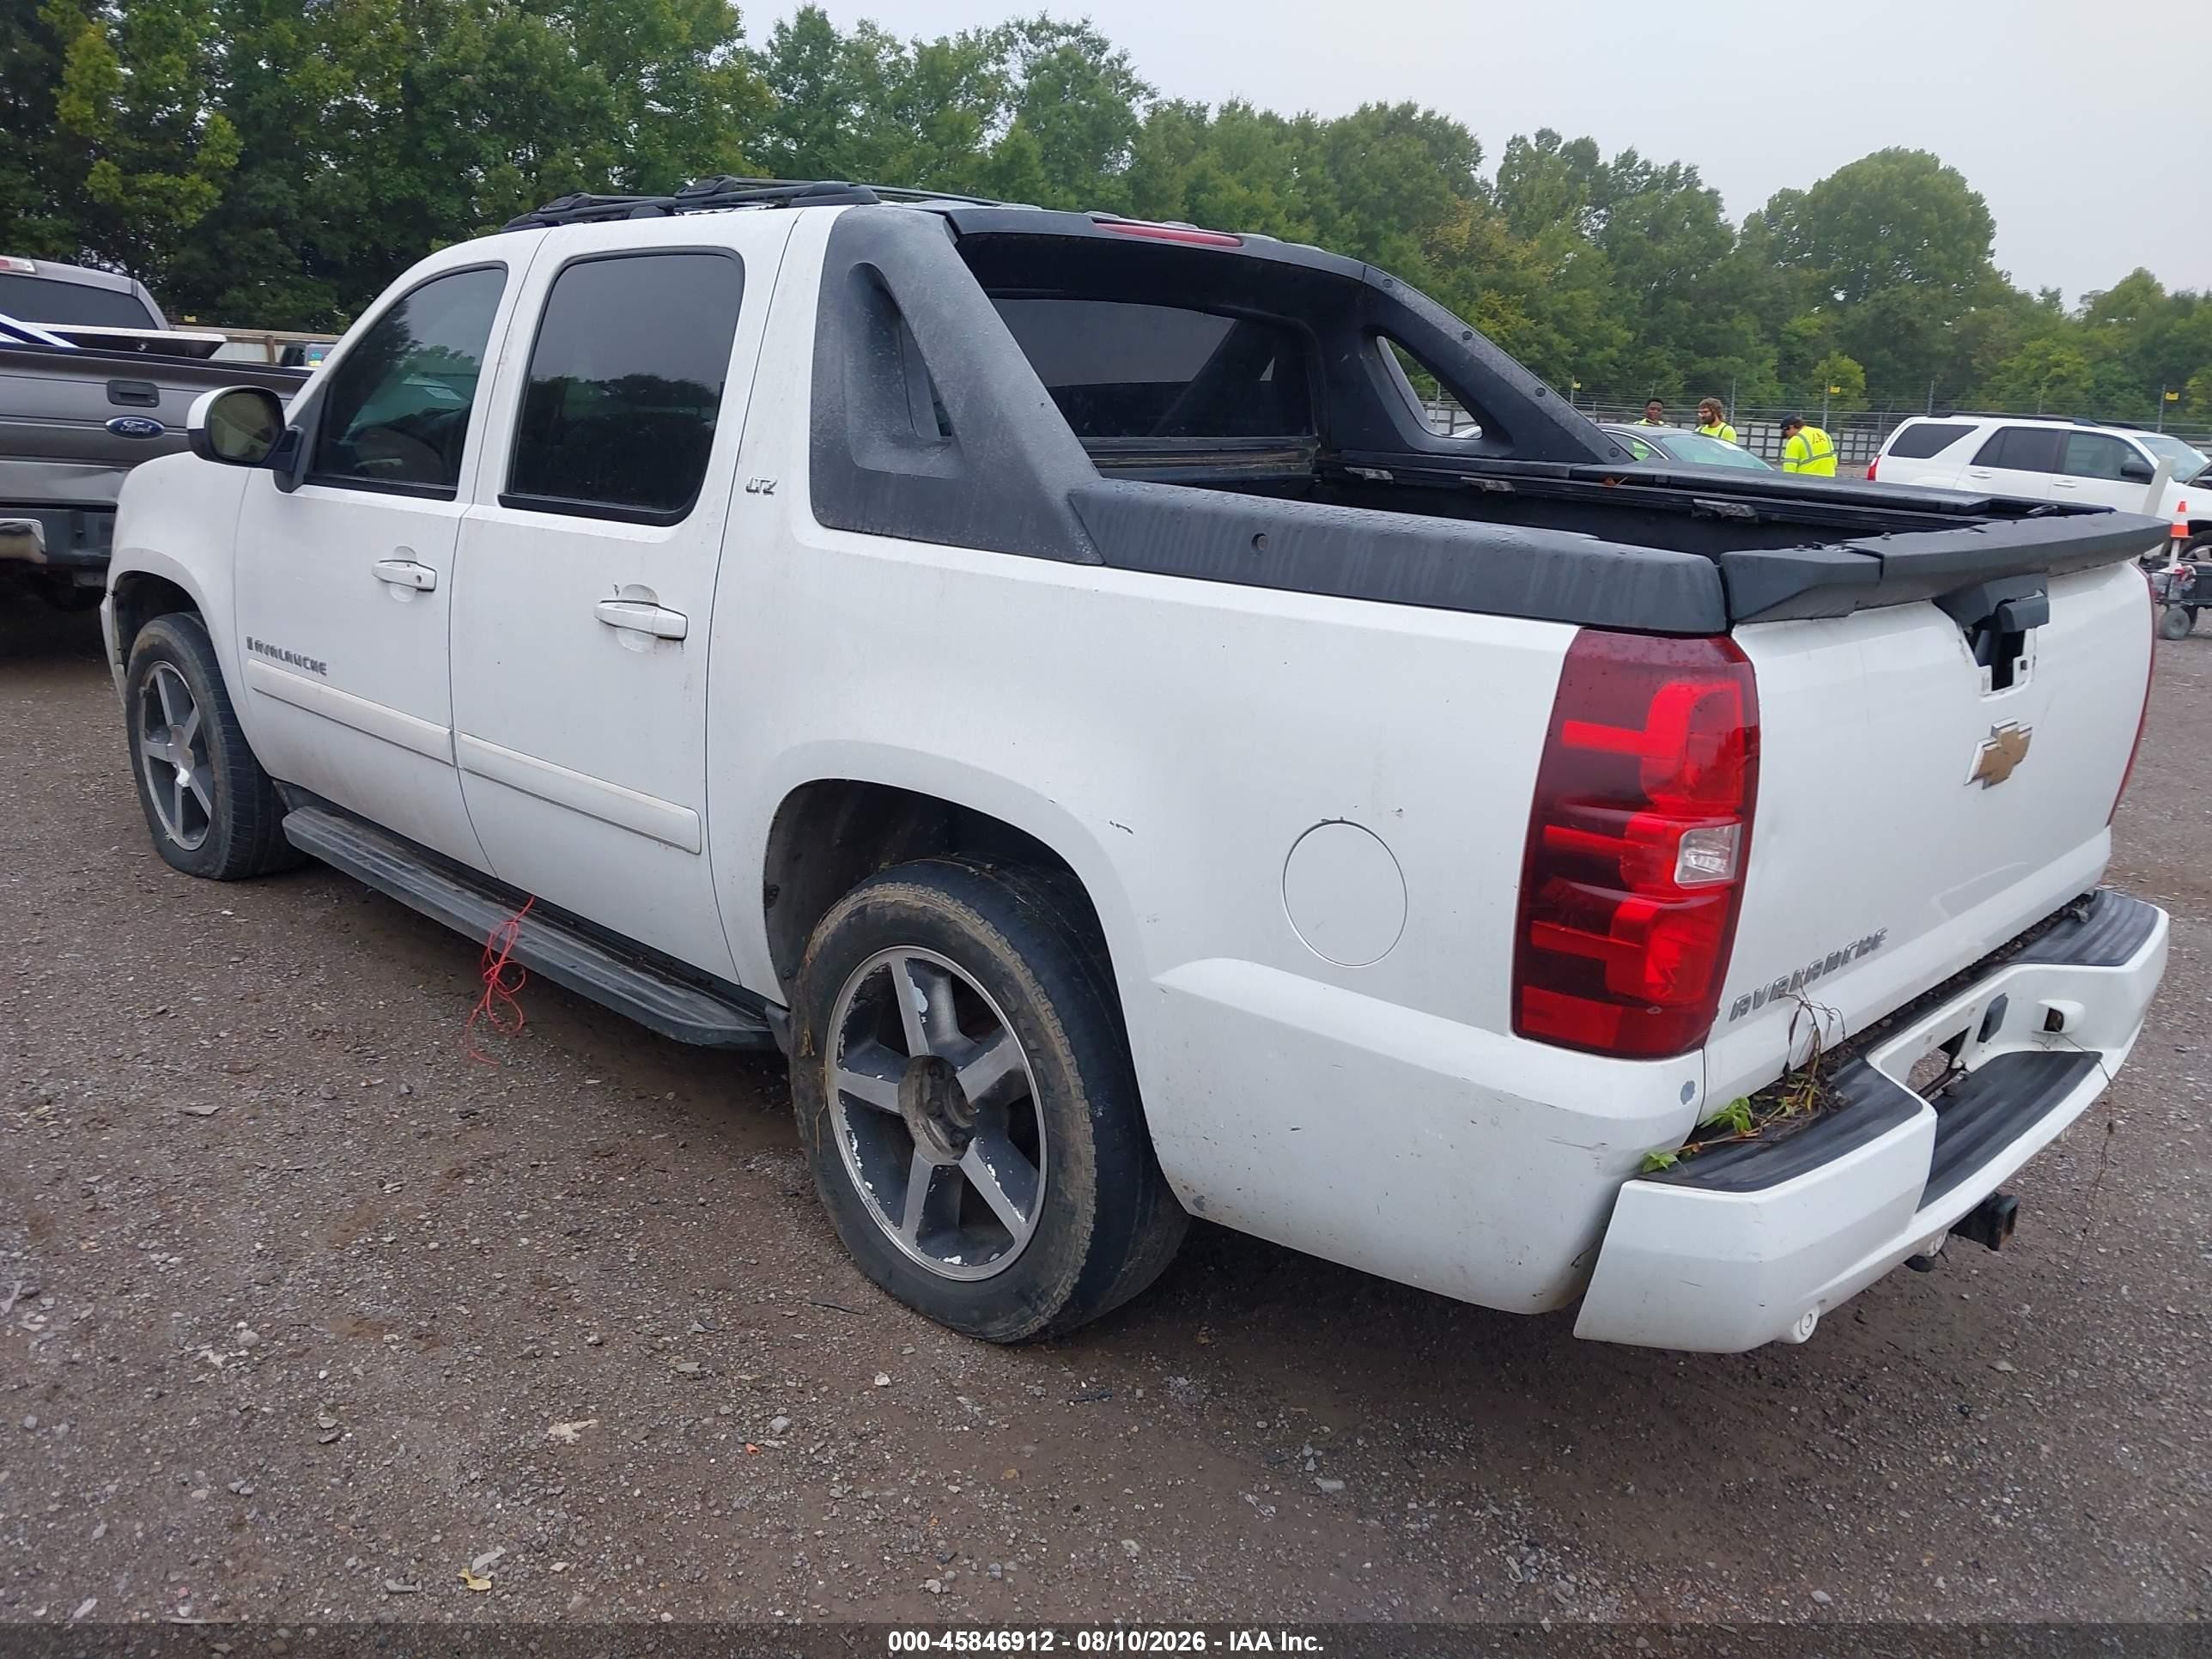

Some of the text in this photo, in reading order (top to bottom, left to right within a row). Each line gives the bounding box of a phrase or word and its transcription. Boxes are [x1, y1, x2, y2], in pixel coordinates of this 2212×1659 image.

[745, 477, 778, 495] LTZ
[254, 639, 327, 677] AVALANCHE
[1729, 927, 1888, 1022] AVALANCHE
